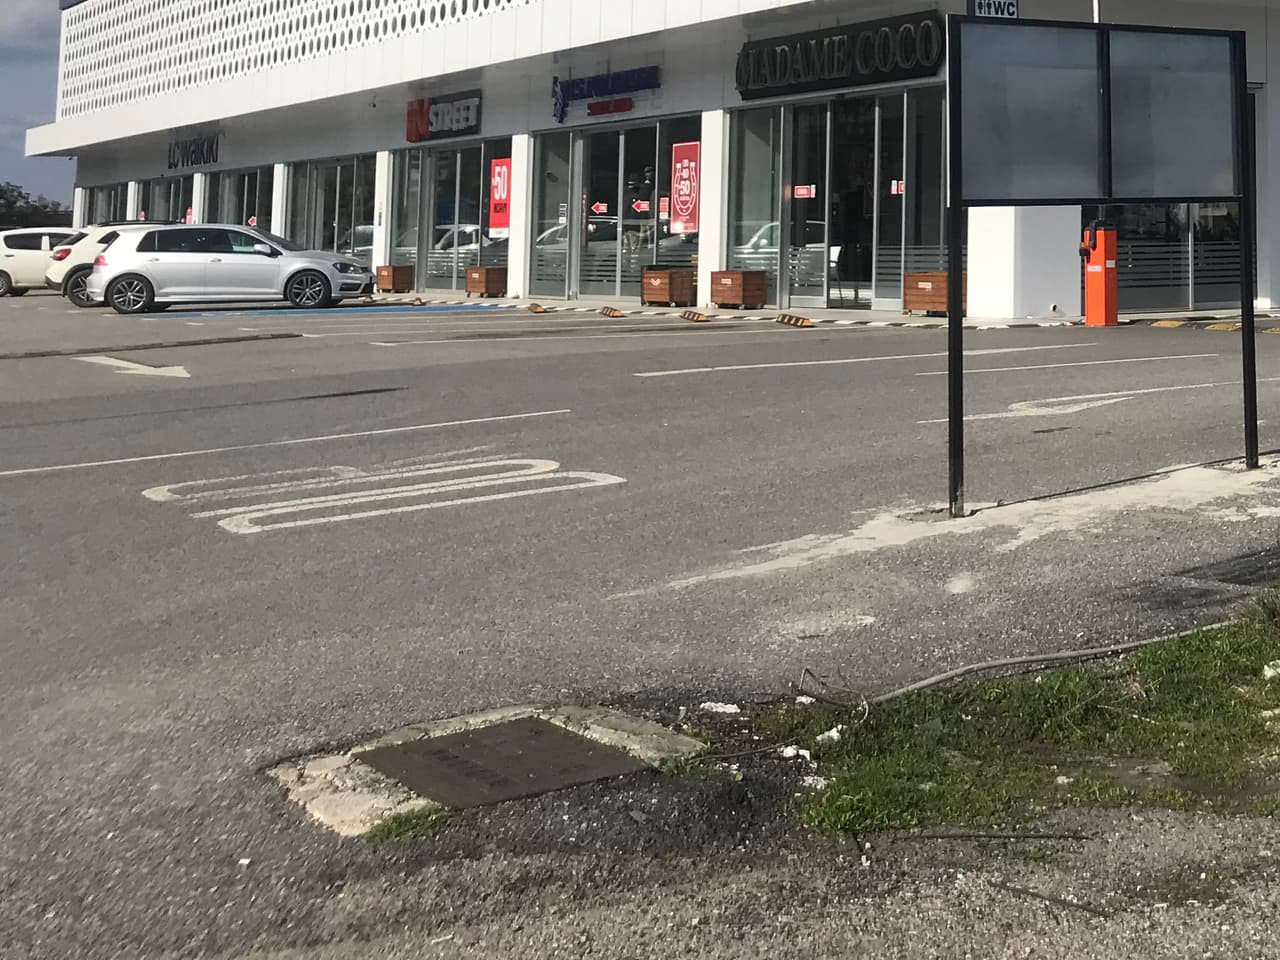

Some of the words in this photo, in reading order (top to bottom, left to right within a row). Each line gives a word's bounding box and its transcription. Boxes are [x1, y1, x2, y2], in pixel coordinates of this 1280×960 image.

[993, 0, 1016, 17] WC
[736, 34, 848, 89] MADAME
[855, 19, 942, 75] COCO
